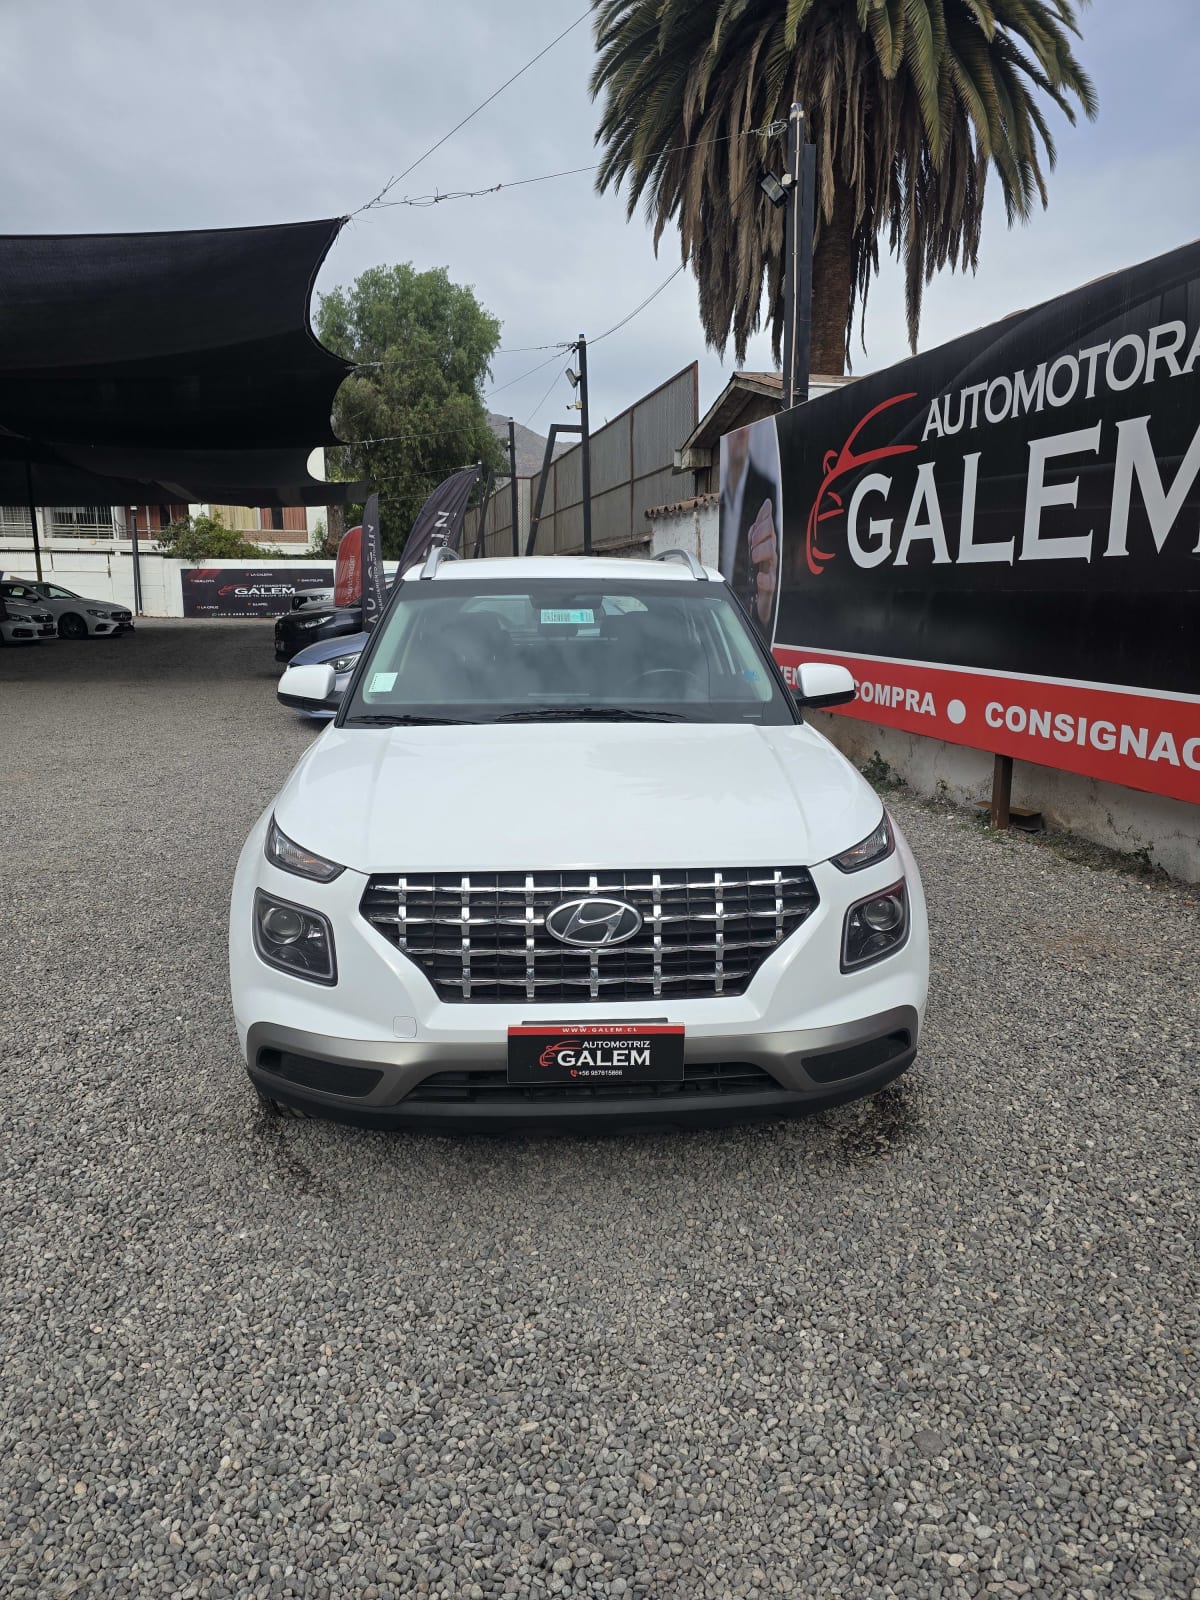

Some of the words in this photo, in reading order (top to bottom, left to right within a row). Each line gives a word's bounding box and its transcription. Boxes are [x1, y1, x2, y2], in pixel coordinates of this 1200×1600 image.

[847, 414, 1200, 569] GALEM
[234, 587, 296, 595] GALEM
[582, 1040, 651, 1048] AUTOMOTRIZ
[557, 1050, 651, 1067] GALEM
